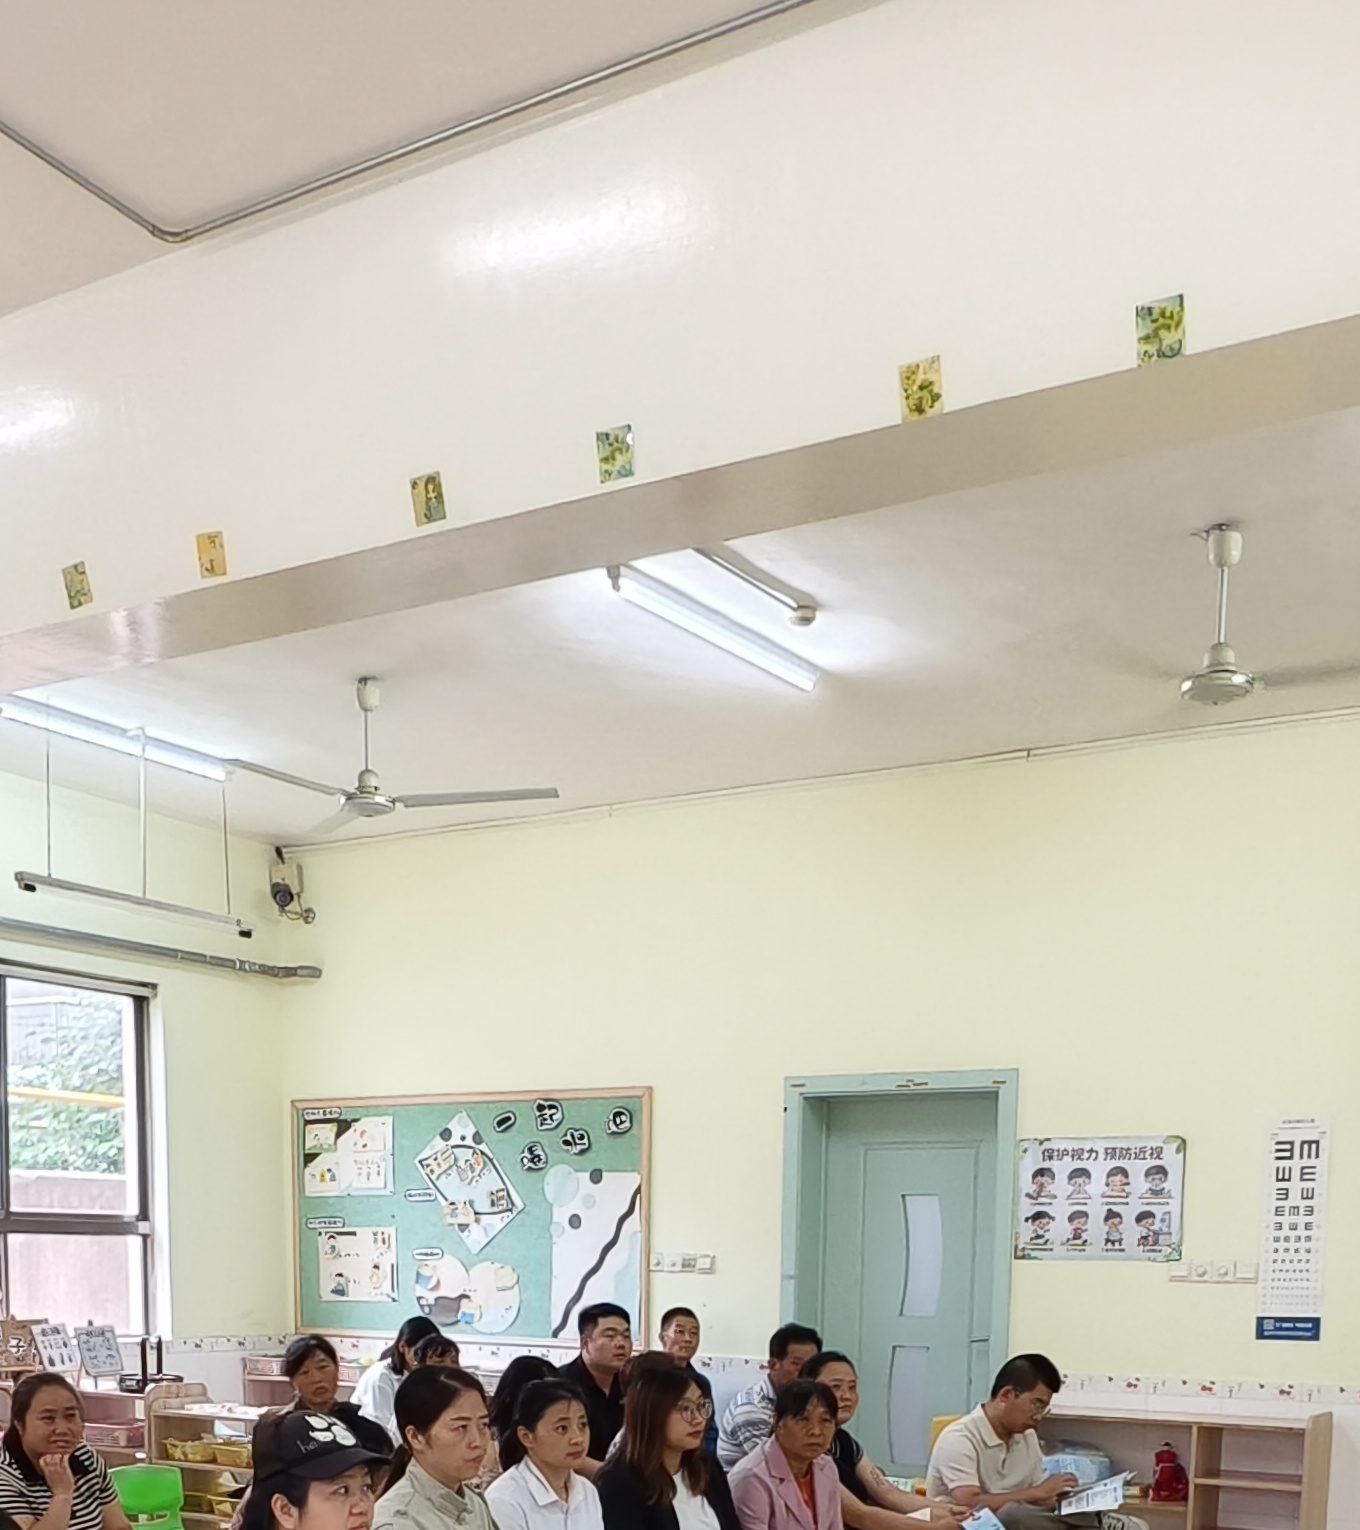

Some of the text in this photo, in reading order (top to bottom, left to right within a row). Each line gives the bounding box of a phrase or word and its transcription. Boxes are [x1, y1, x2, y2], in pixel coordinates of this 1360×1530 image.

[1041, 1146, 1164, 1162] 保护视力 预防近视
